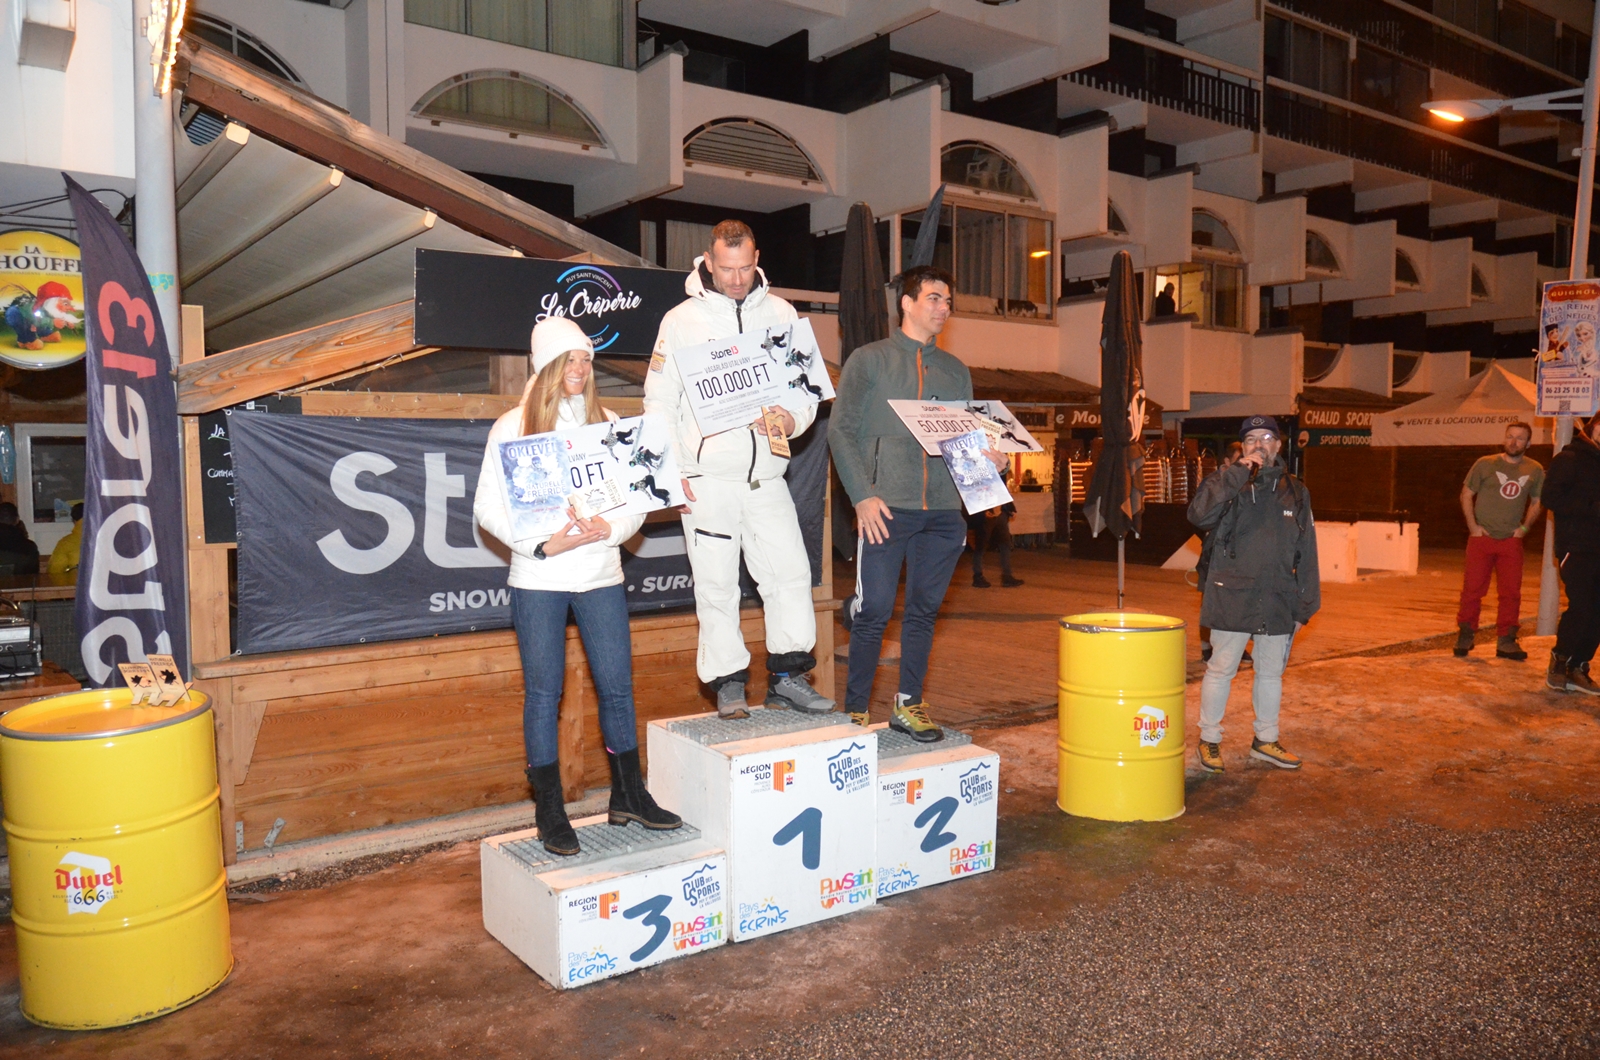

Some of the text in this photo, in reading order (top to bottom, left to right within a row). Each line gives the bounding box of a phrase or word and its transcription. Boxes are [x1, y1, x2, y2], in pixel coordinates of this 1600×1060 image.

[25, 246, 41, 254] LA
[566, 274, 577, 283] PUY
[592, 273, 614, 290] VINCENT
[1551, 289, 1597, 297] GUIGNOL
[535, 288, 643, 323] La Crêperie
[1566, 303, 1596, 311] REINE
[1549, 313, 1597, 323] DES NEIGES
[695, 368, 753, 400] 100.000
[752, 363, 771, 385] FT
[1304, 410, 1340, 425] CHAUD
[1345, 411, 1374, 426] SPORT
[1407, 417, 1433, 425] VENTE
[1442, 416, 1482, 424] LOCATION
[1497, 415, 1519, 423] SKIS
[917, 420, 978, 433] 50.000 FT
[1320, 435, 1341, 445] SPORT
[508, 438, 557, 459] OKLEVÉL
[207, 468, 235, 479] COMMA
[585, 461, 605, 486] FT
[1505, 484, 1517, 496] 11
[1133, 715, 1169, 731] Duvel
[754, 771, 771, 781] SUD
[828, 756, 852, 784] CLUB
[835, 763, 869, 791] SPORTS
[892, 788, 906, 796] SUD
[960, 774, 980, 798] CLUB
[965, 780, 993, 804] SPORTS
[913, 796, 959, 853] 2
[772, 806, 823, 870] 1
[54, 864, 123, 891] Duvel
[682, 876, 705, 901] CLUB
[689, 881, 720, 907] SPORTS
[582, 903, 598, 912] SUD
[739, 902, 759, 914] Pays
[622, 894, 673, 962] 3
